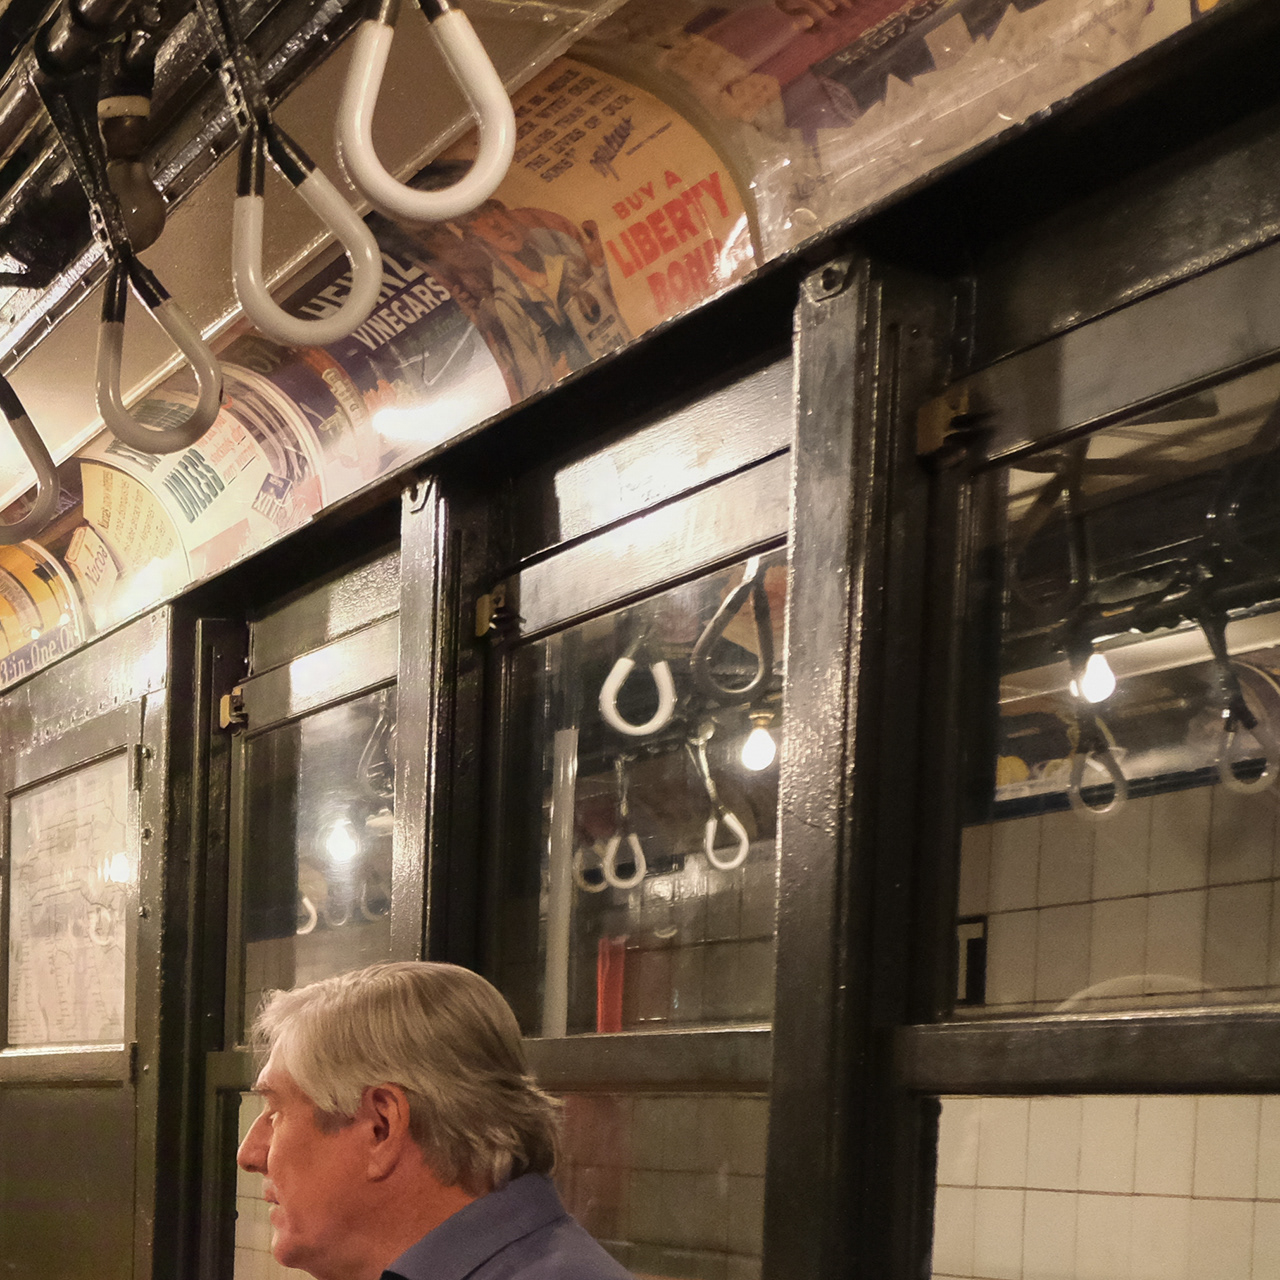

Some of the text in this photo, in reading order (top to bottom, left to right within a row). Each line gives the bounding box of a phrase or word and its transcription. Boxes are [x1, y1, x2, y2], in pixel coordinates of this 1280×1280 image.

[568, 76, 597, 97] OUR
[525, 94, 635, 172] THE LIVES OF OUR
[606, 171, 730, 279] LIBERTY
[612, 170, 683, 220] BUY A
[352, 277, 451, 351] VINEGARS
[162, 448, 226, 524] UNLESS
